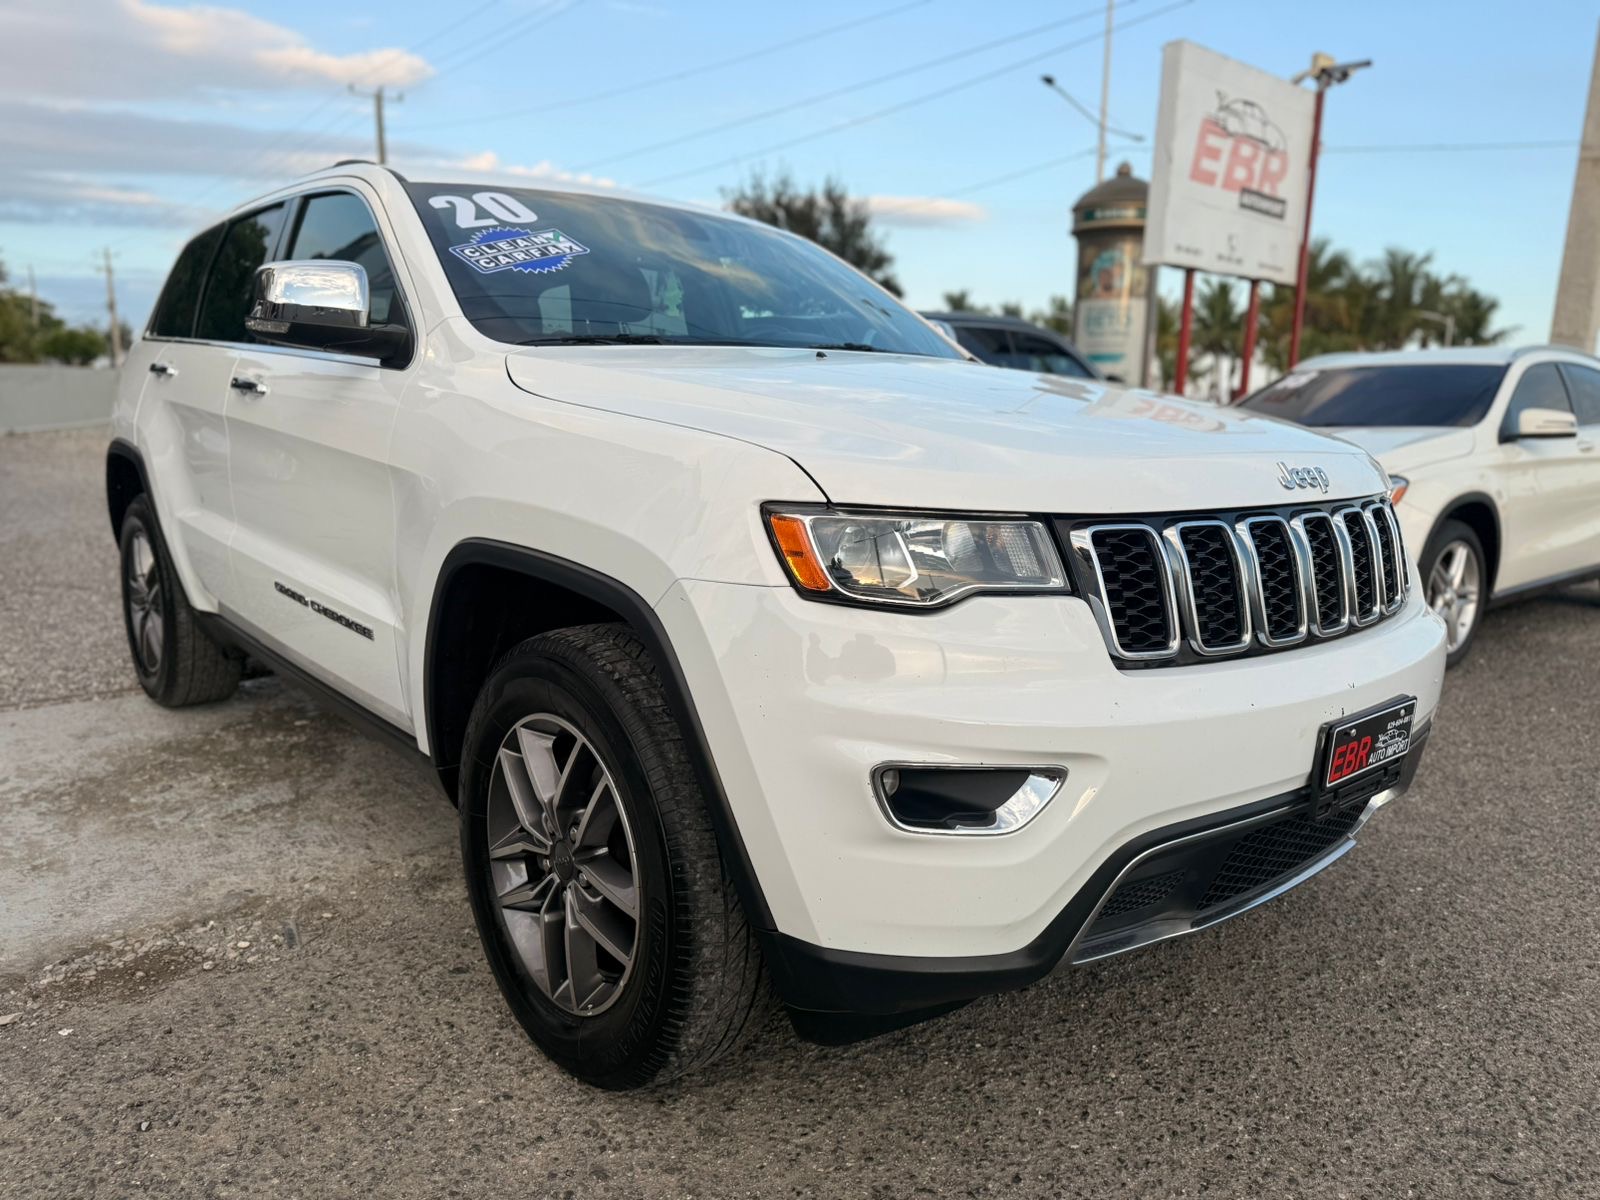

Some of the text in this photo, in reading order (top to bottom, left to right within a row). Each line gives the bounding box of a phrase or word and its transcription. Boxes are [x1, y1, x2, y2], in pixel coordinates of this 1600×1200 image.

[1189, 117, 1289, 197] EBR
[428, 191, 538, 228] 20
[463, 234, 547, 258] CLEAN
[478, 242, 583, 268] CARFAX
[1277, 461, 1330, 494] Jeep
[1329, 735, 1409, 782] EBR AUTO IMPORT
